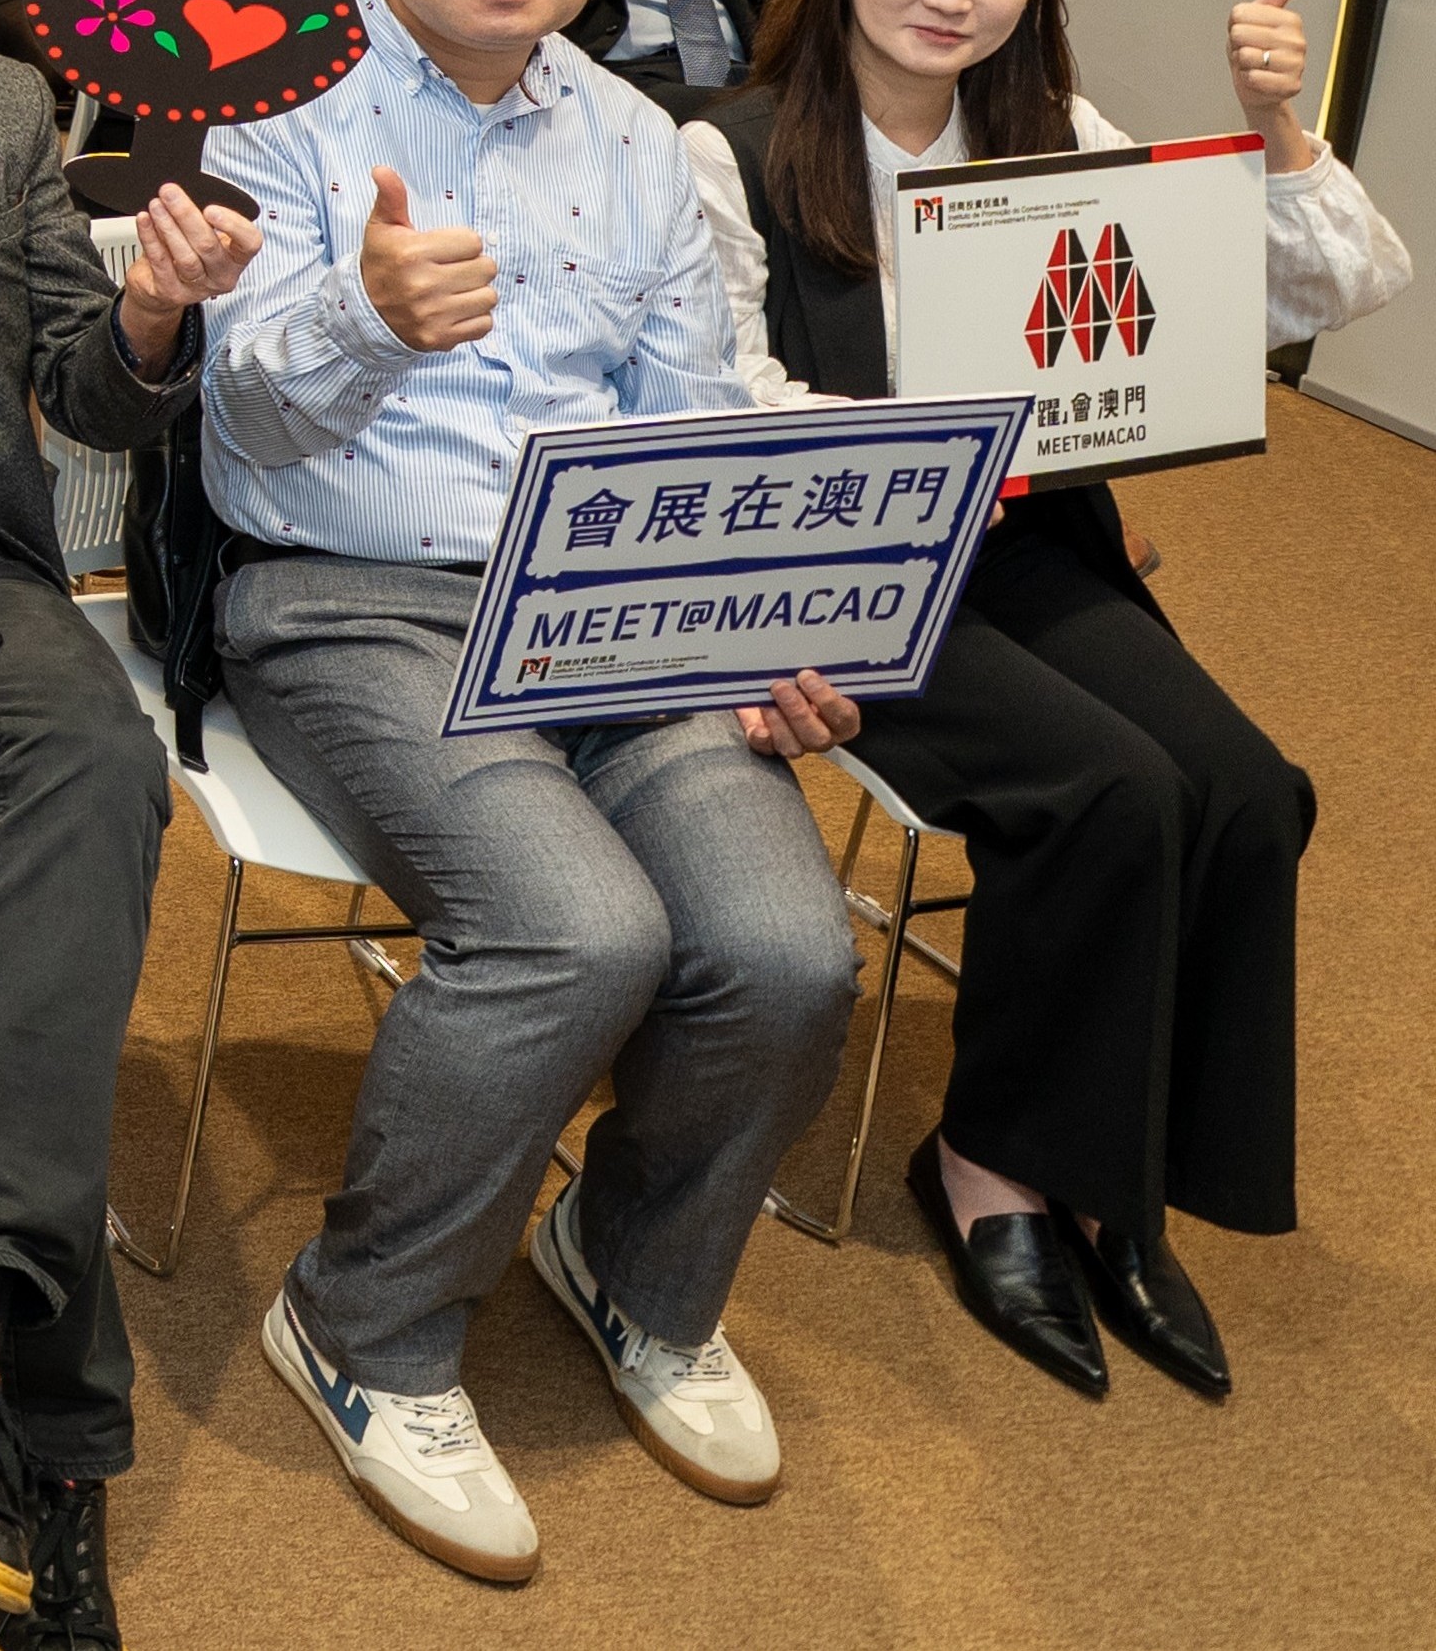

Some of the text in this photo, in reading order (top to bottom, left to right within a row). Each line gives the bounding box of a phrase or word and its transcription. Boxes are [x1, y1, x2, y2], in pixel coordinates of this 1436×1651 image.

[1037, 425, 1146, 456] MEET@MACAO
[564, 465, 950, 552] 會展在澳門
[525, 583, 905, 650] MEET@MACAO
